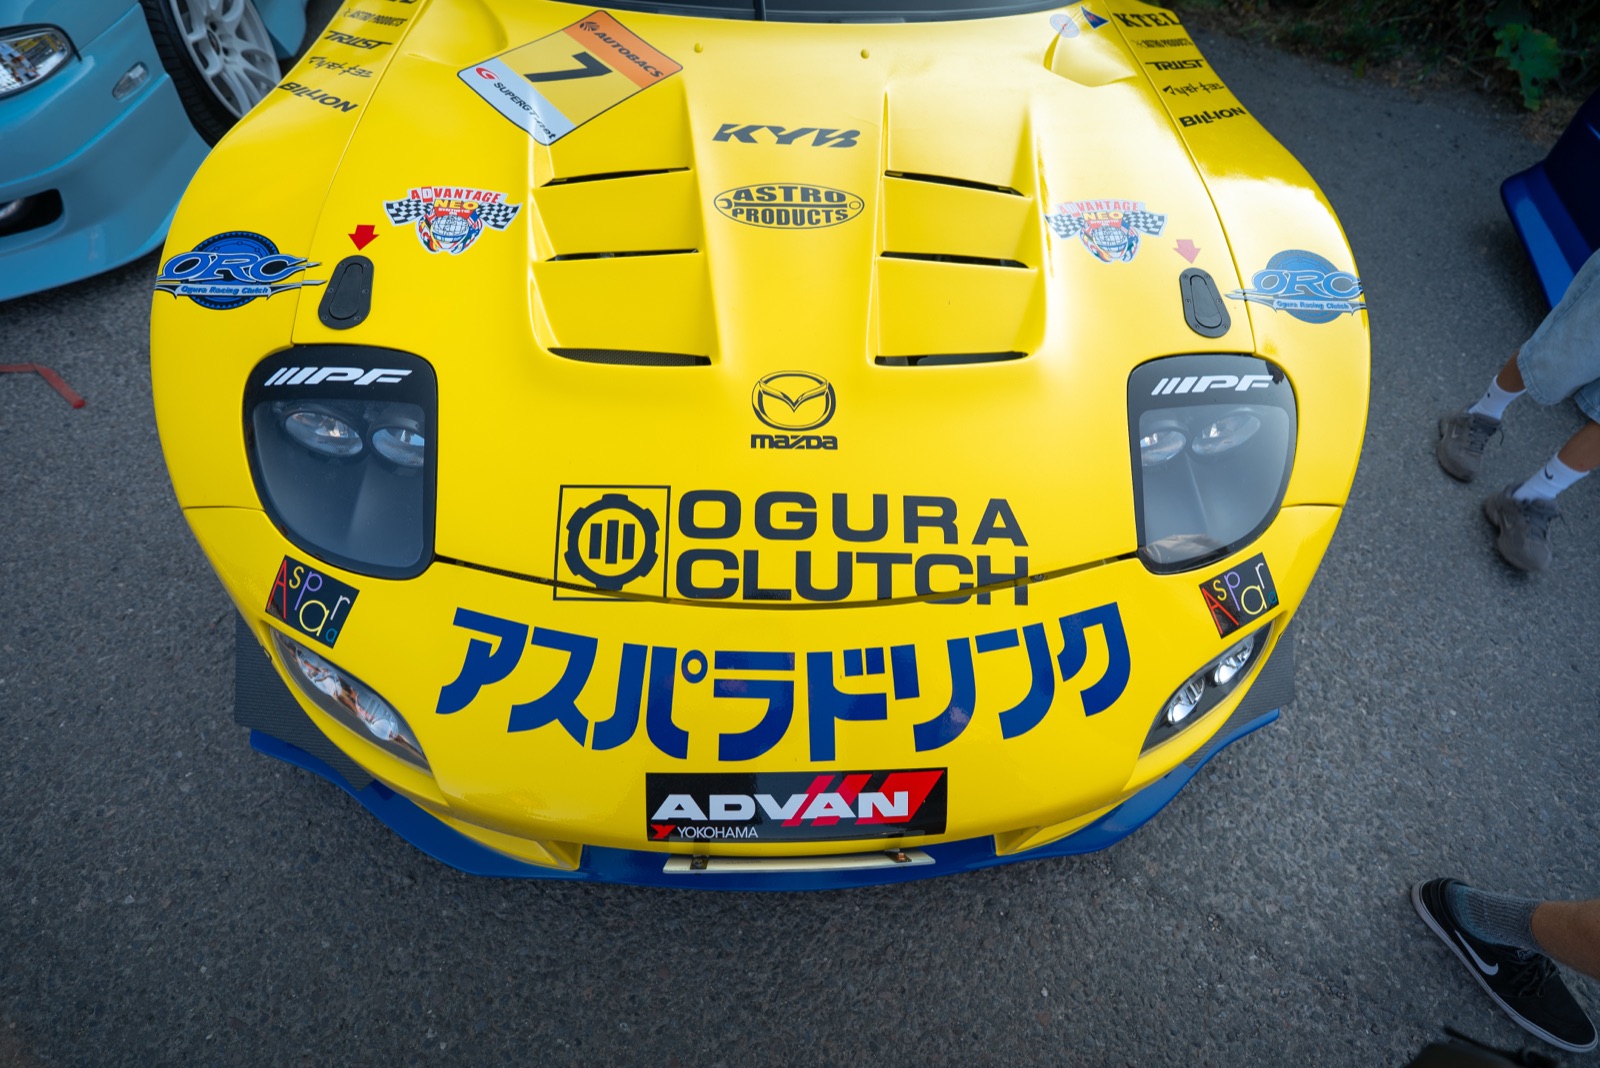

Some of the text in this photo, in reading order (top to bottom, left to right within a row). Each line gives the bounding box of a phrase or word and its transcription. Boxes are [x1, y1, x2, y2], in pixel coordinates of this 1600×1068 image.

[323, 30, 393, 50] TRUST
[594, 31, 664, 78] AUTOBACS
[523, 51, 613, 83] 7
[1144, 59, 1204, 71] TRUST
[279, 81, 359, 113] BILLION
[1178, 106, 1247, 128] BILLION
[712, 123, 861, 148] KYB
[410, 186, 501, 204] ADVANTAGE
[732, 185, 847, 203] ASTRO
[433, 199, 480, 211] NEO
[1058, 201, 1138, 217] ADVANTAGE
[731, 208, 849, 227] PRODUCTS
[1082, 211, 1124, 221] NEO
[155, 251, 309, 283] ORC
[181, 285, 269, 296] Ogura Racing Clutch
[1251, 269, 1362, 299] ORC
[1299, 301, 1325, 310] Racing
[1325, 302, 1350, 310] Clutch
[750, 433, 839, 451] mazda
[677, 489, 1029, 547] OGURA
[675, 548, 1030, 606] CLUTCH
[434, 602, 1132, 762] アスパラドリンク
[650, 790, 909, 821] ADVAN
[676, 826, 759, 839] YOKOHAMA
